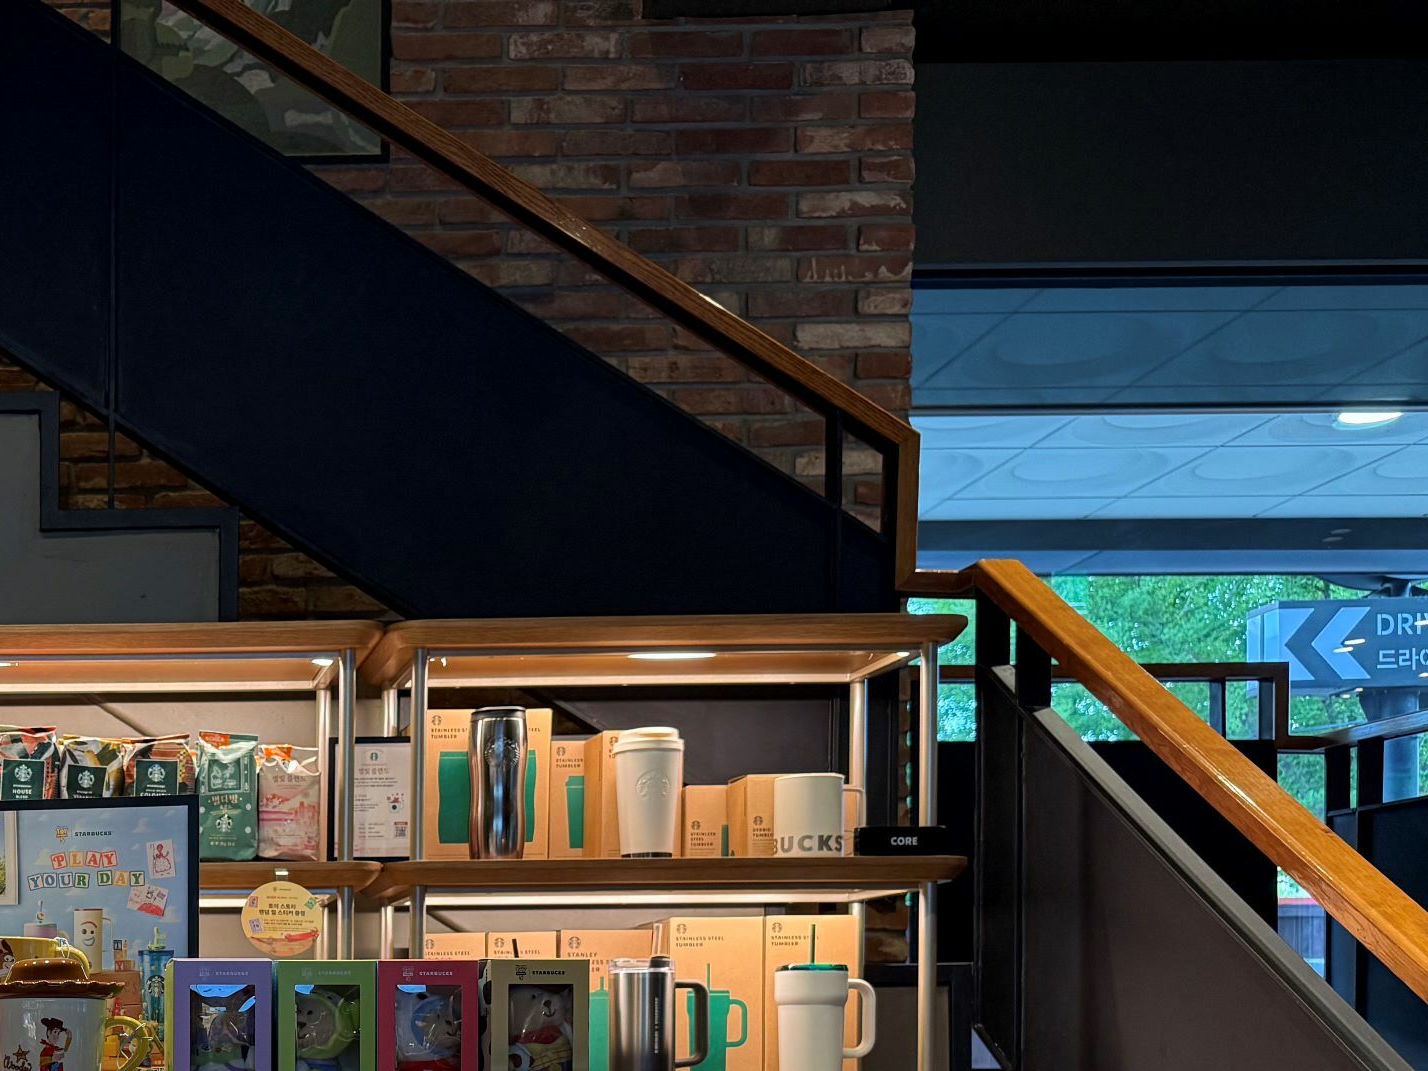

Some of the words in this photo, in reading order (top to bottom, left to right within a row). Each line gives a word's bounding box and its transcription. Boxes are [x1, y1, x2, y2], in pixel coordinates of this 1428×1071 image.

[890, 836, 918, 846] CORE
[52, 851, 117, 869] PLAY
[28, 873, 90, 890] YOUR
[97, 871, 145, 887] DAY
